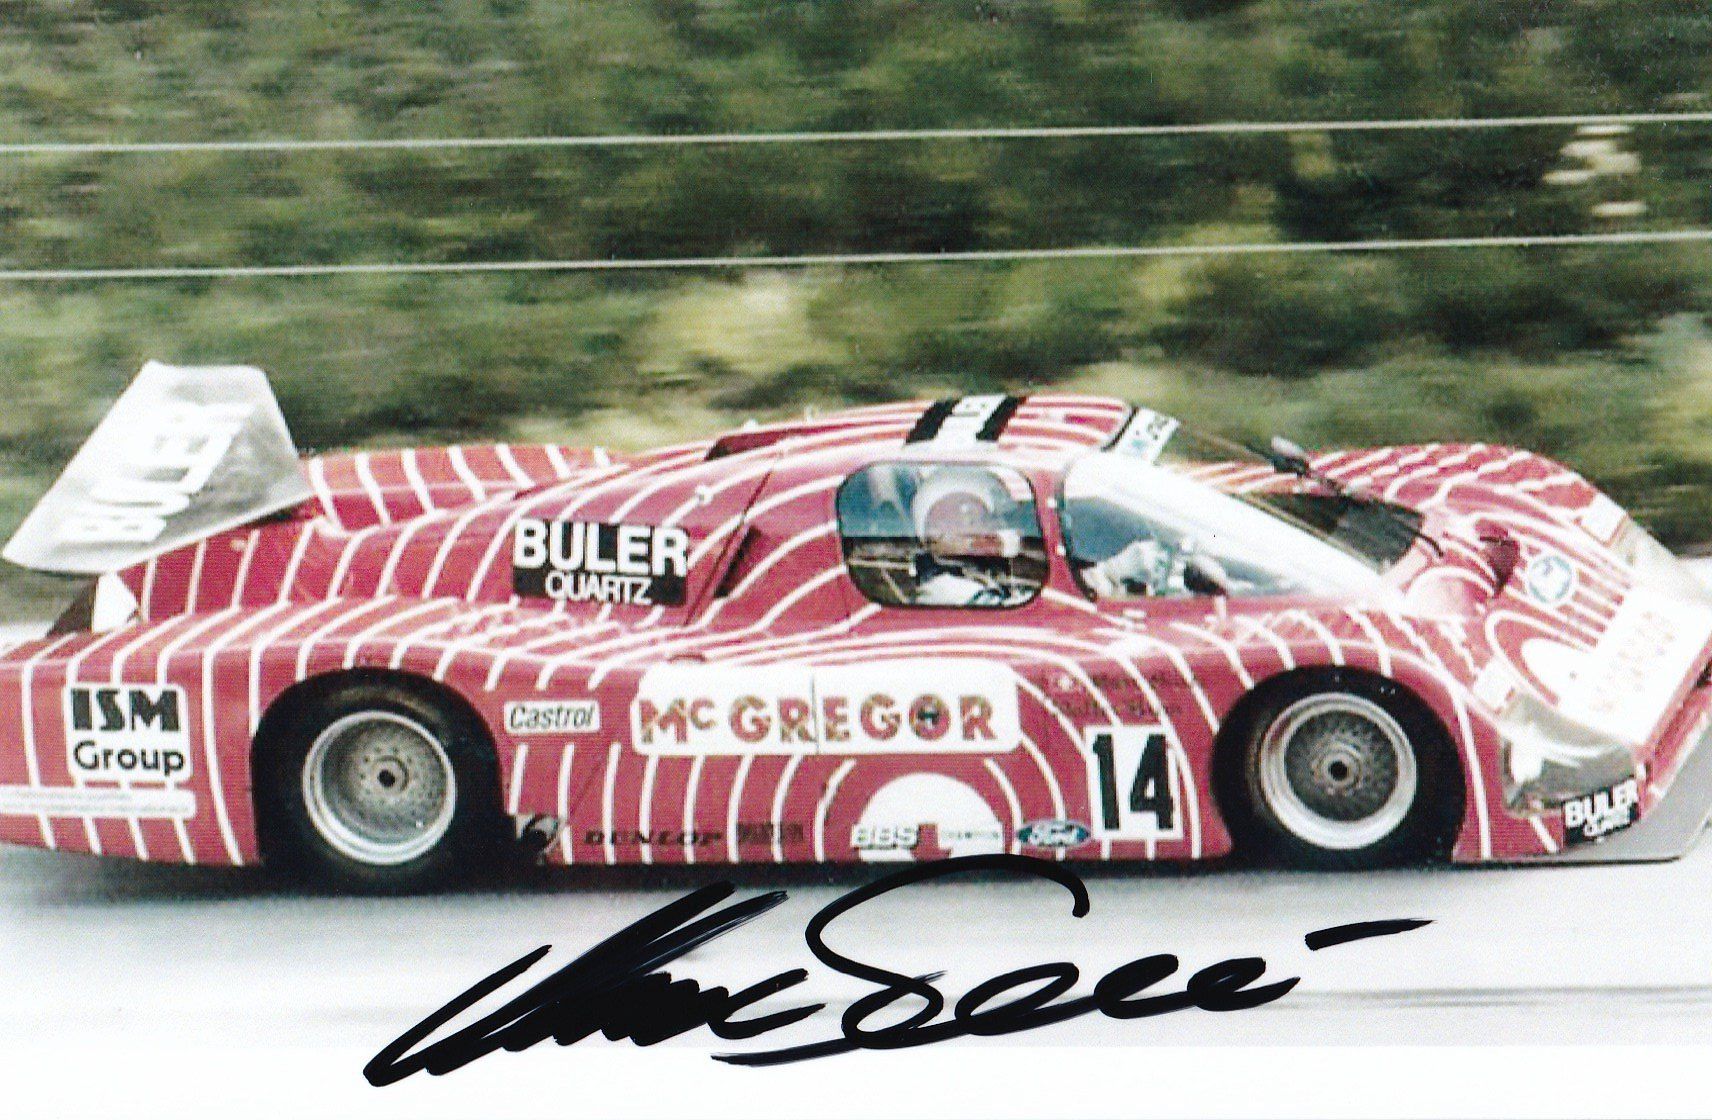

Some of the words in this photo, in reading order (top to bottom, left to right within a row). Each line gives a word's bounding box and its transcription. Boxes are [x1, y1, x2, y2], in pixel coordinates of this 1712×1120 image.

[514, 519, 689, 577] BULER
[545, 571, 652, 606] QUARTZ
[71, 688, 180, 731] ISM
[510, 704, 595, 729] Castrol
[74, 740, 184, 776] Group
[1093, 733, 1174, 831] 14
[853, 825, 919, 849] BBS
